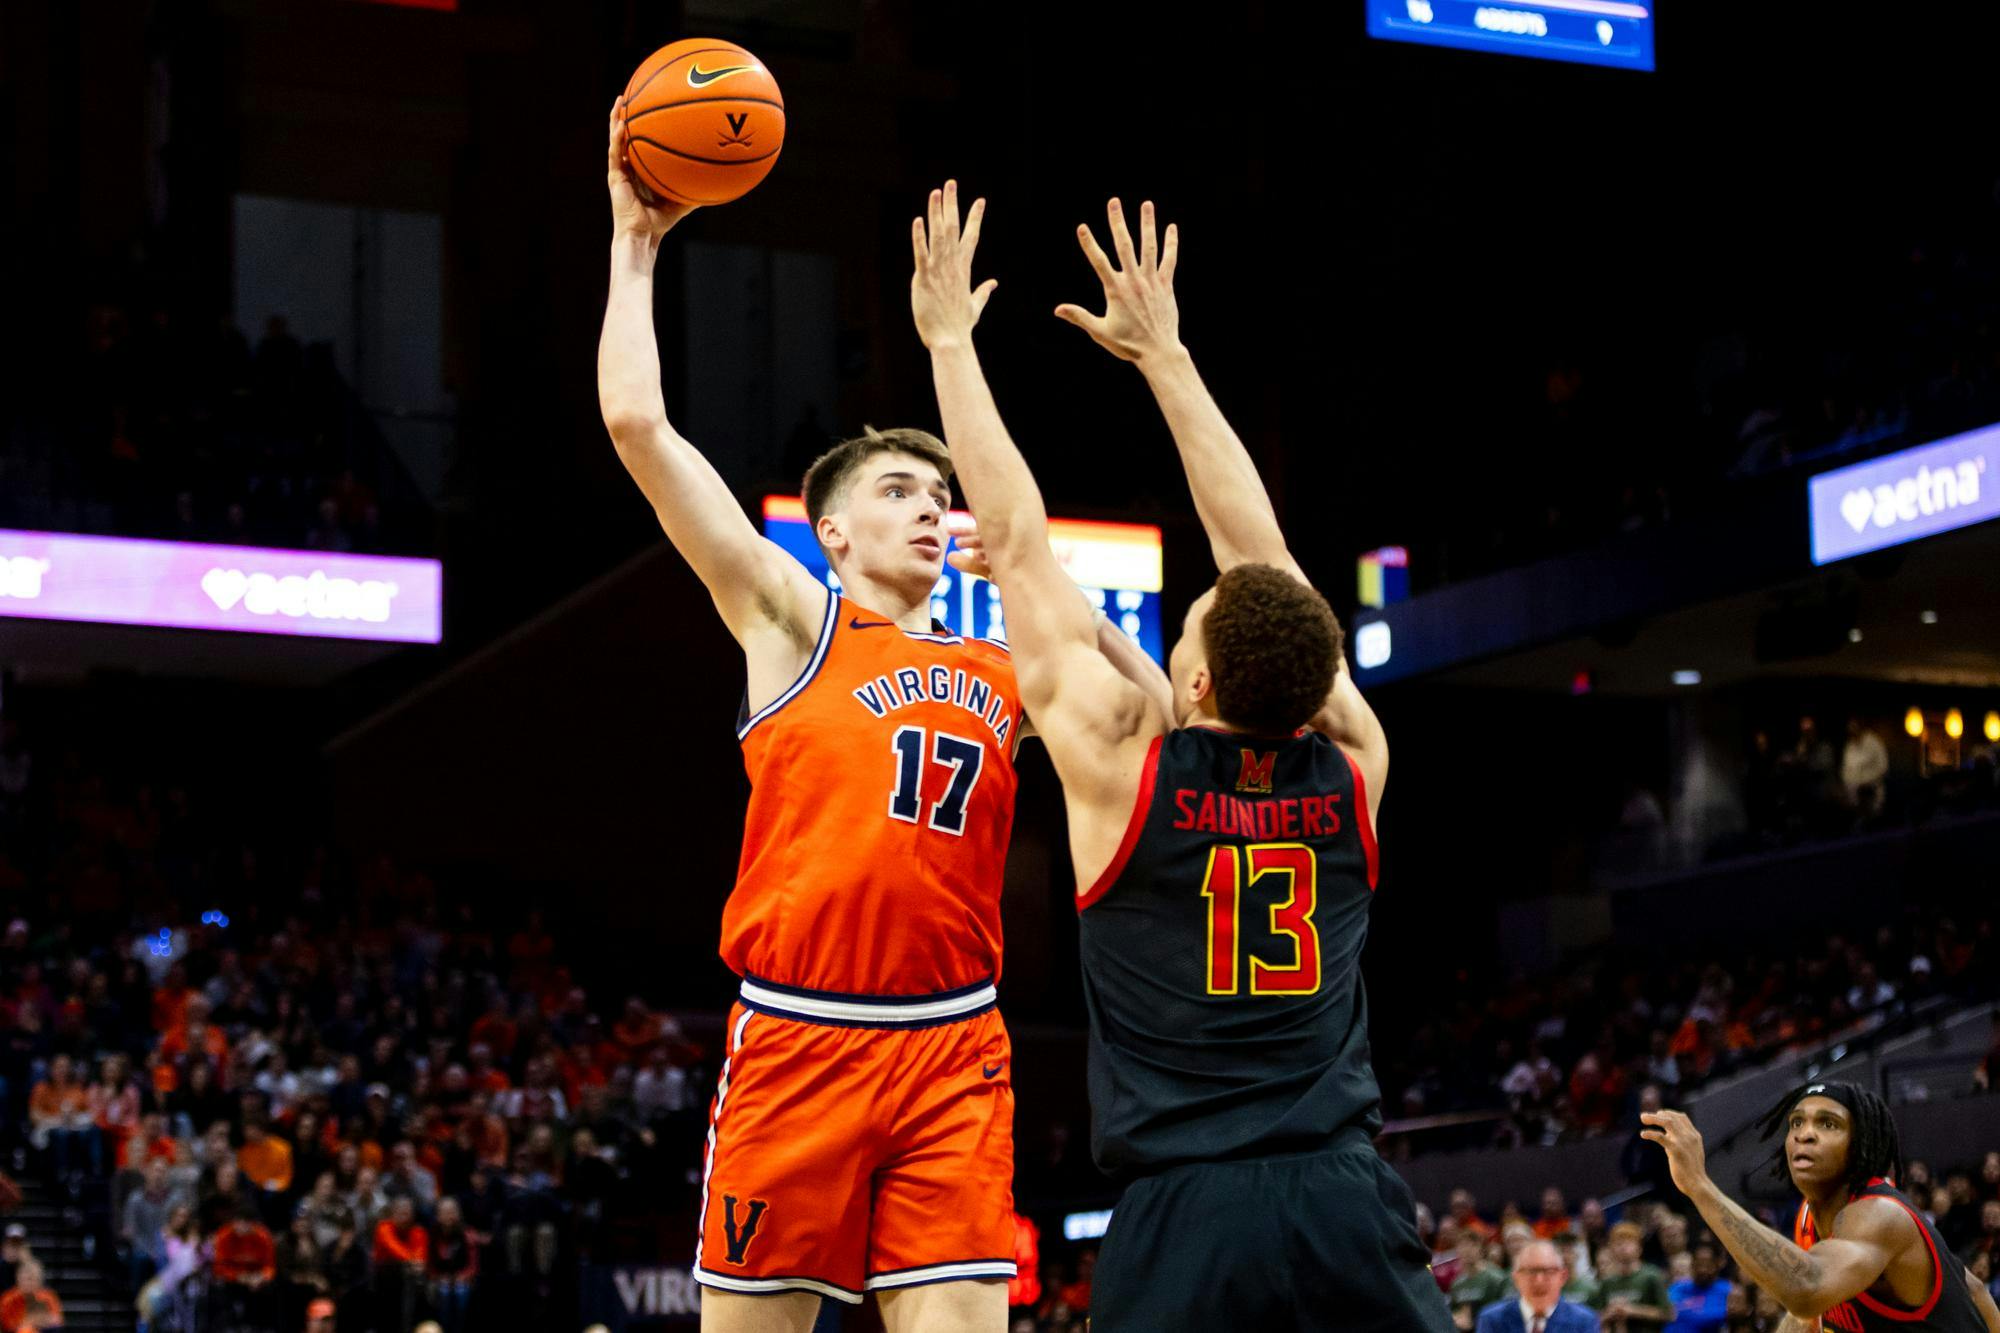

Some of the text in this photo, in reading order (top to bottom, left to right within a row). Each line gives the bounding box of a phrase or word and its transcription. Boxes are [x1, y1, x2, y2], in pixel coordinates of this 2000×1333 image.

[726, 113, 748, 137] V
[1872, 459, 1979, 528] aetna
[852, 664, 1011, 748] VIRGINIA
[888, 725, 985, 836] 17
[1235, 748, 1278, 787] M
[1173, 789, 1341, 840] SAUNDERS
[1201, 843, 1321, 995] 13
[722, 1193, 769, 1267] V
